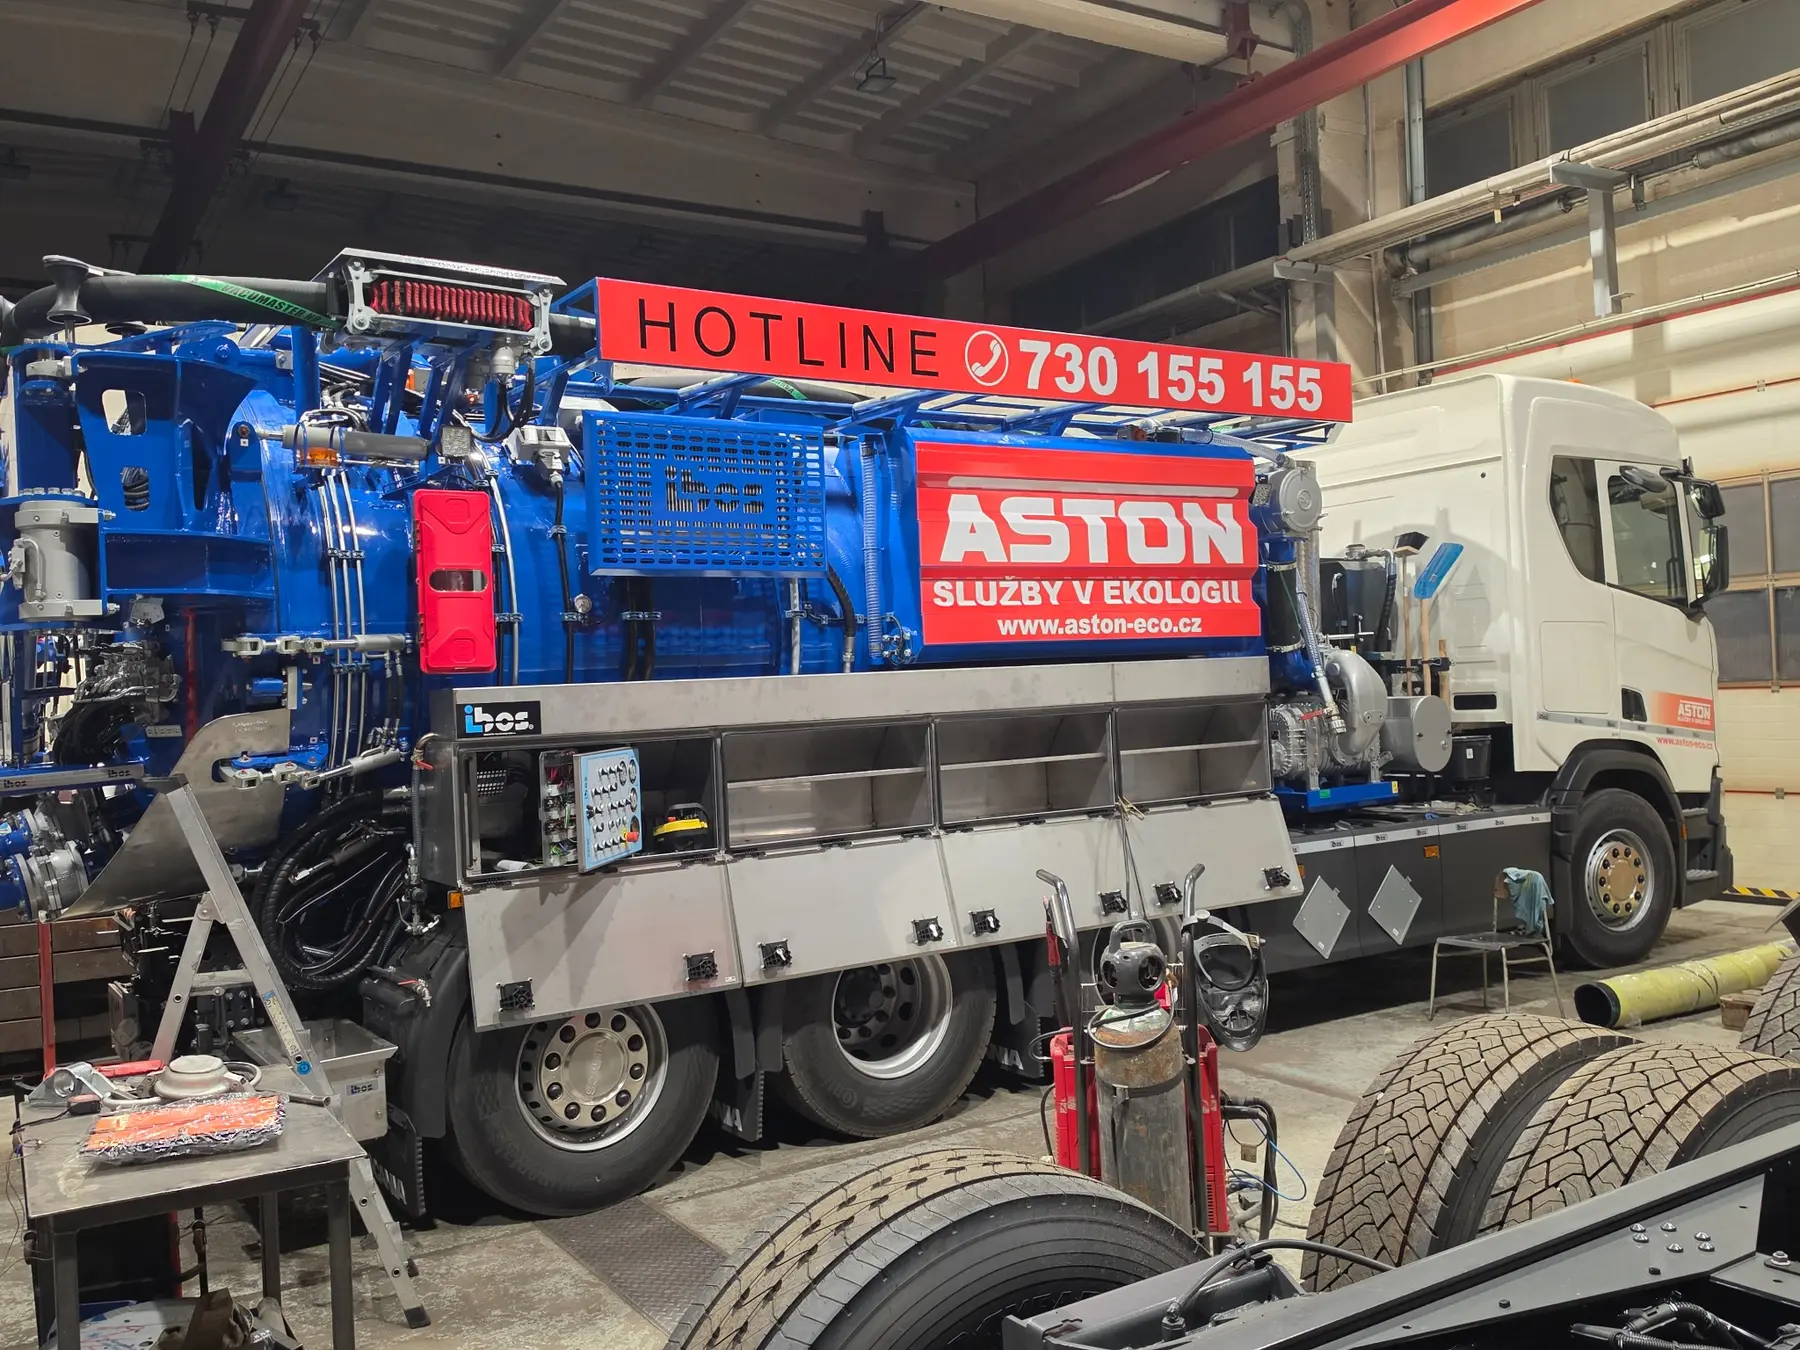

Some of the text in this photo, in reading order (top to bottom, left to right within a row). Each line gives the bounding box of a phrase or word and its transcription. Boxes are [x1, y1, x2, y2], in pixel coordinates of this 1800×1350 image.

[637, 298, 1324, 412] HOTLINE 730 155 155
[939, 493, 1245, 565] ASTON
[932, 577, 1243, 607] SLUŽBY V EKOLOGII
[997, 613, 1202, 637] www.aston-eco.cz
[1678, 703, 1711, 720] ASTON
